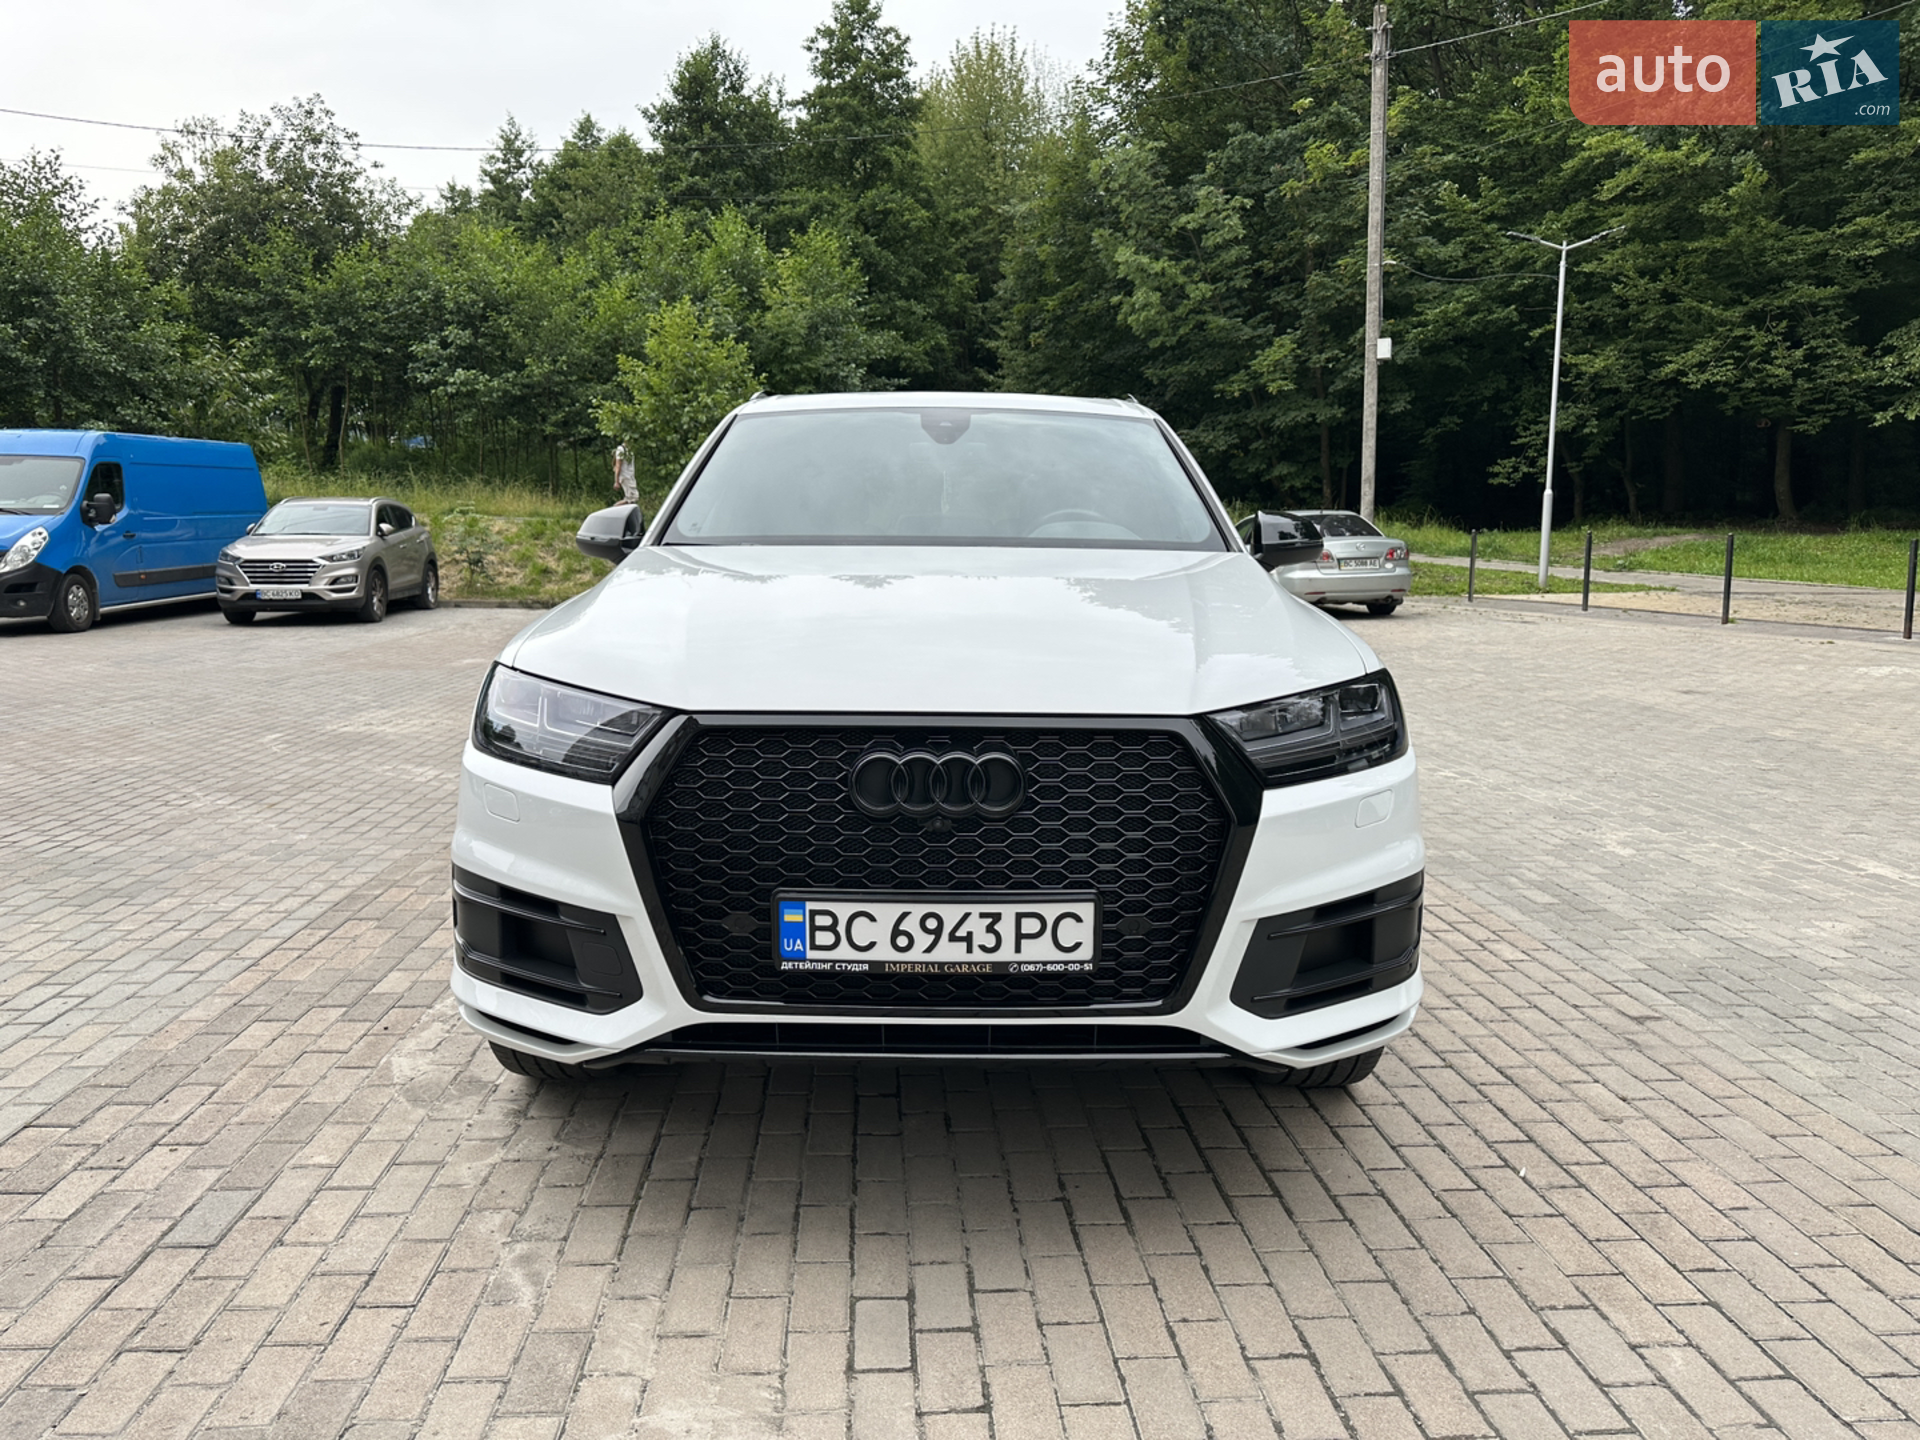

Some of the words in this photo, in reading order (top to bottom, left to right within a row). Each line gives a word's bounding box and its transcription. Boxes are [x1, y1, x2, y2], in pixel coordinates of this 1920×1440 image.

[808, 908, 878, 953] BC
[890, 911, 1003, 955] 6943
[1014, 911, 1084, 954] PC
[783, 938, 804, 951] UA
[780, 961, 833, 971] ДЕТЕЙЛІНГ
[835, 963, 869, 972] СТУДІЯ
[884, 962, 941, 973] IMPERIAL
[944, 963, 993, 973] GARAGE
